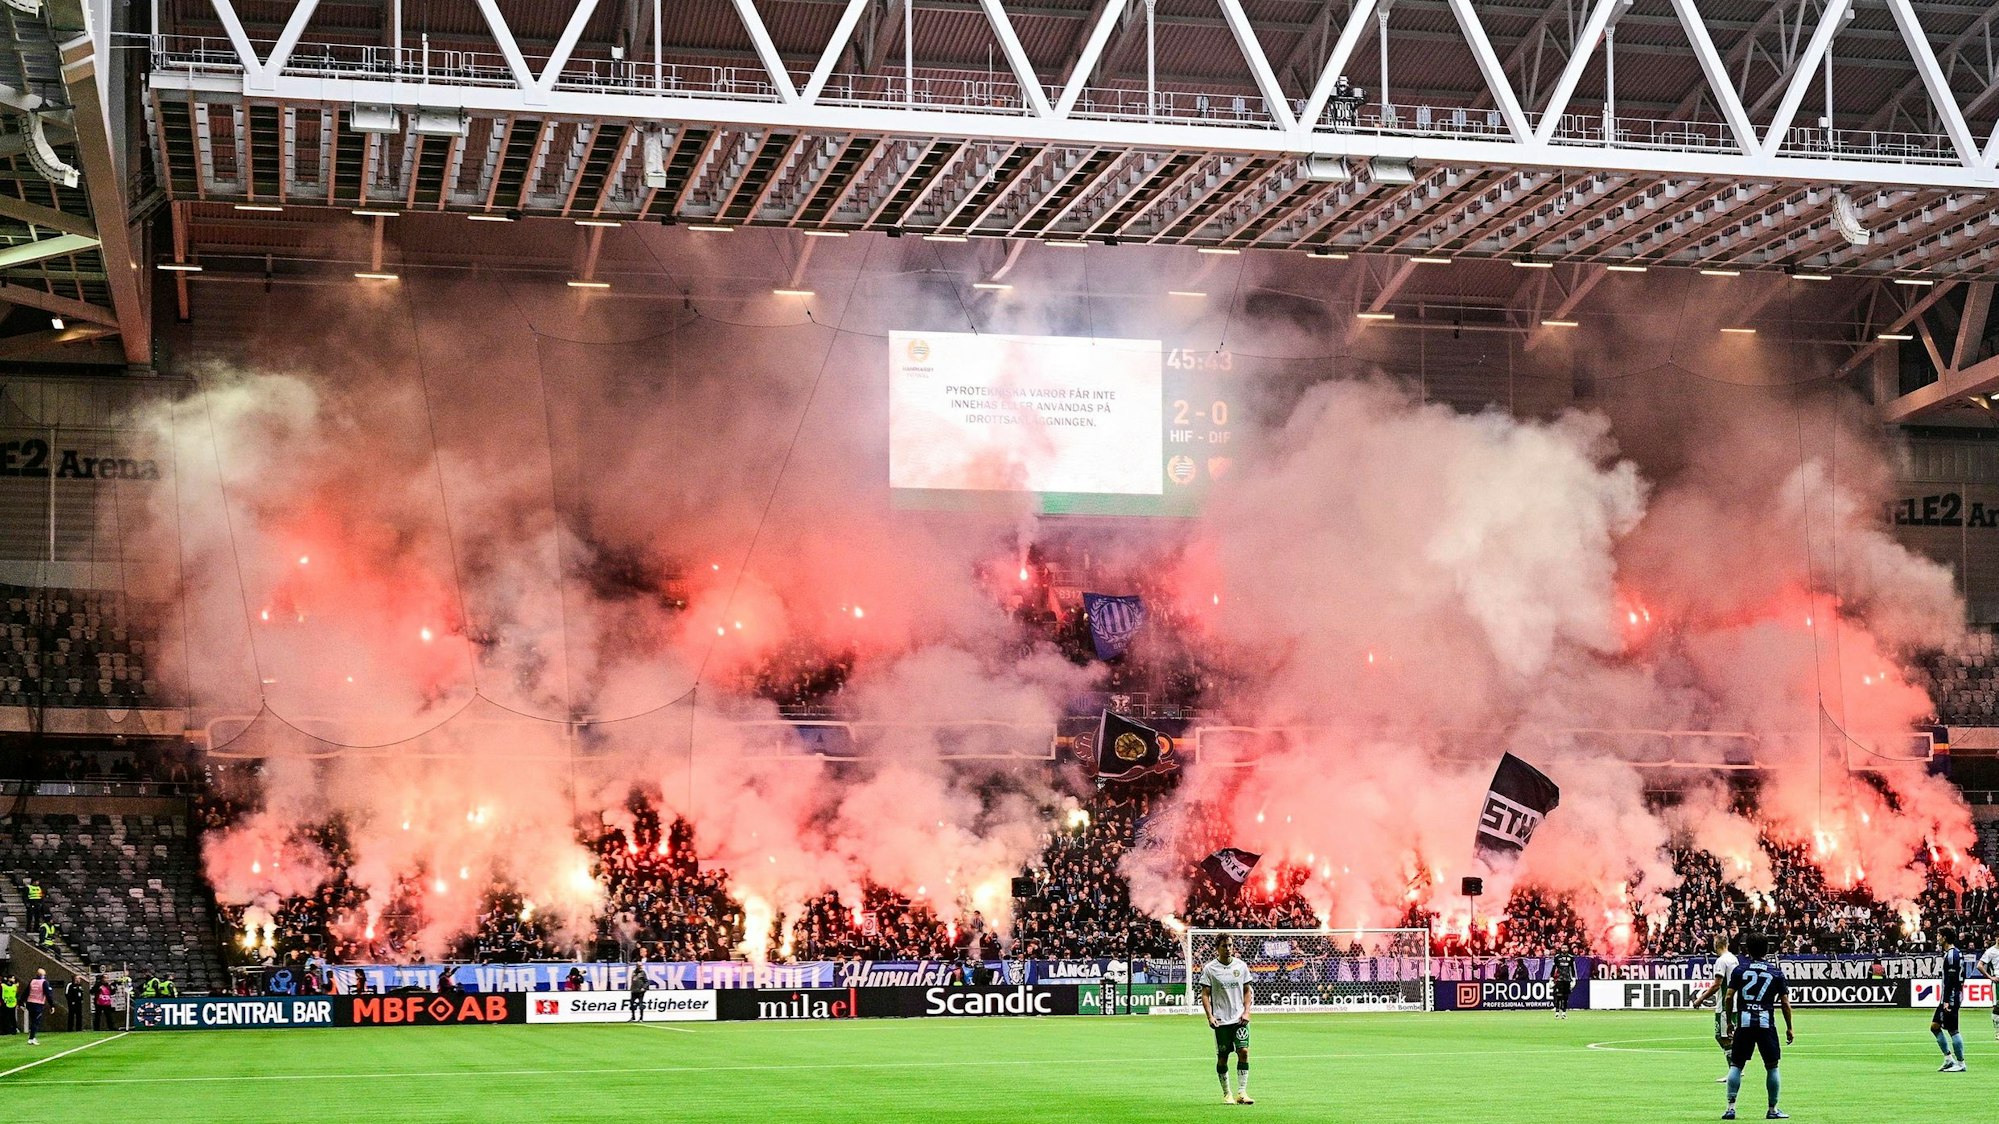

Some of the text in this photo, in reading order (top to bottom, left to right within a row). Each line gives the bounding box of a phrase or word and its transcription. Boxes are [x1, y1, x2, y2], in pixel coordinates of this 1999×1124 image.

[1166, 348, 1233, 371] 45:43
[1029, 388, 1066, 399] VAROR
[1069, 387, 1089, 399] FÅR
[1093, 390, 1116, 400] INTE
[951, 400, 1111, 413] INNEHAS ELLER ANVÄNDAS PÅ
[1173, 399, 1189, 425] 2
[1212, 400, 1228, 426] 0
[1170, 430, 1193, 443] HIF
[1208, 431, 1232, 444] DIF
[55, 450, 160, 480] Arena
[1048, 960, 1101, 978] LÅNGA
[1655, 963, 1690, 980] MOT
[1742, 970, 1774, 1002] 27
[1774, 986, 1897, 1003] ETODGOLV
[1935, 985, 1994, 1001] IER
[571, 998, 709, 1013] Stena Fstigheter
[758, 987, 857, 1019] milael
[926, 985, 1051, 1015] Scandic
[1105, 983, 1115, 1015] SELECT
[1270, 992, 1319, 1006] Sefina
[1747, 1003, 1764, 1011] TCL
[161, 1000, 331, 1025] THE CENTRAL BAR
[353, 995, 508, 1023] MBF AB
